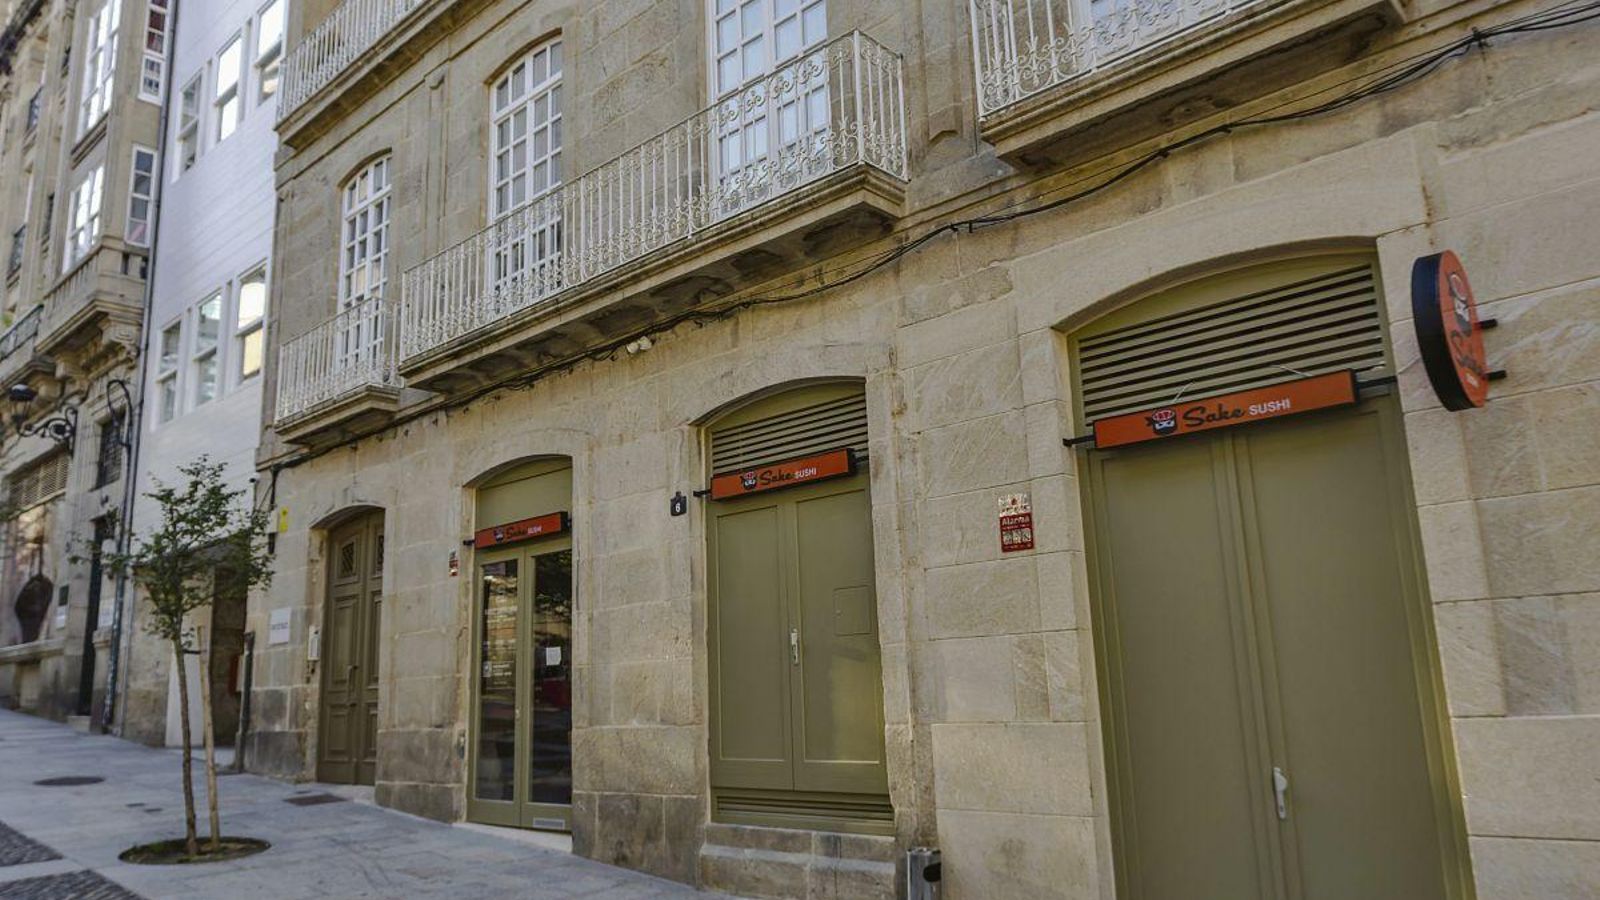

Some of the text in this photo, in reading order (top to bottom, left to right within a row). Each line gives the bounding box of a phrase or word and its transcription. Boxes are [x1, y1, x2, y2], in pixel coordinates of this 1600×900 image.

[1183, 398, 1291, 428] Sake SUSHI
[759, 467, 817, 486] Sake SUSHI
[675, 502, 681, 513] 6
